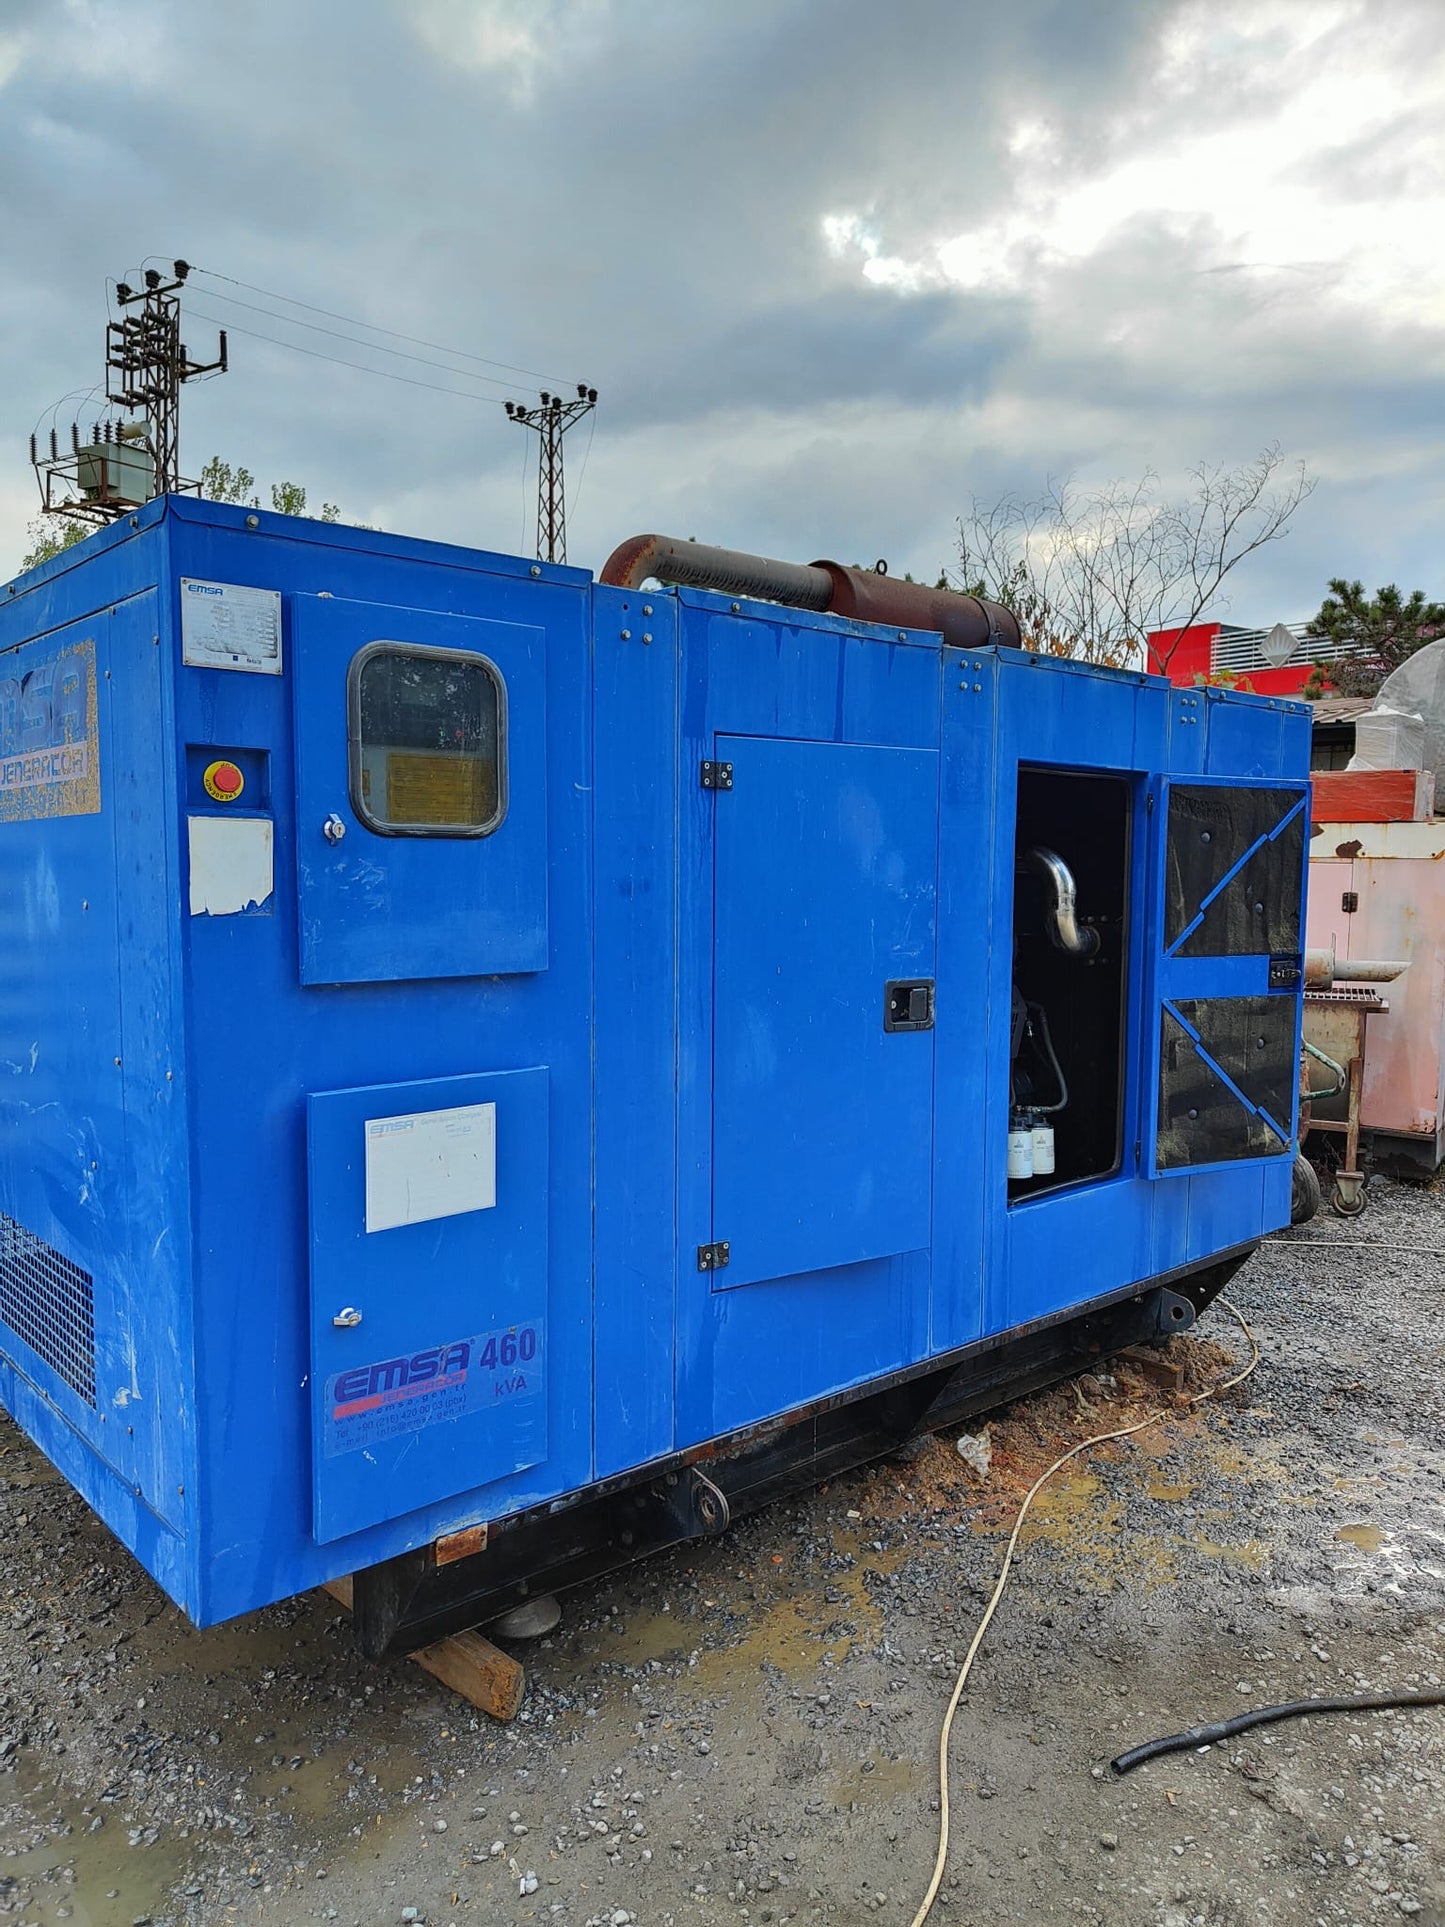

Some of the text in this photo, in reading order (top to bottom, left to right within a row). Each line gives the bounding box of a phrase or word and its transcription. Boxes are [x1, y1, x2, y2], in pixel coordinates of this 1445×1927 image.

[188, 584, 223, 596] EMSA
[370, 1120, 414, 1134] EMSA
[334, 1328, 536, 1403] EMSA 460
[494, 1374, 527, 1397] kVA
